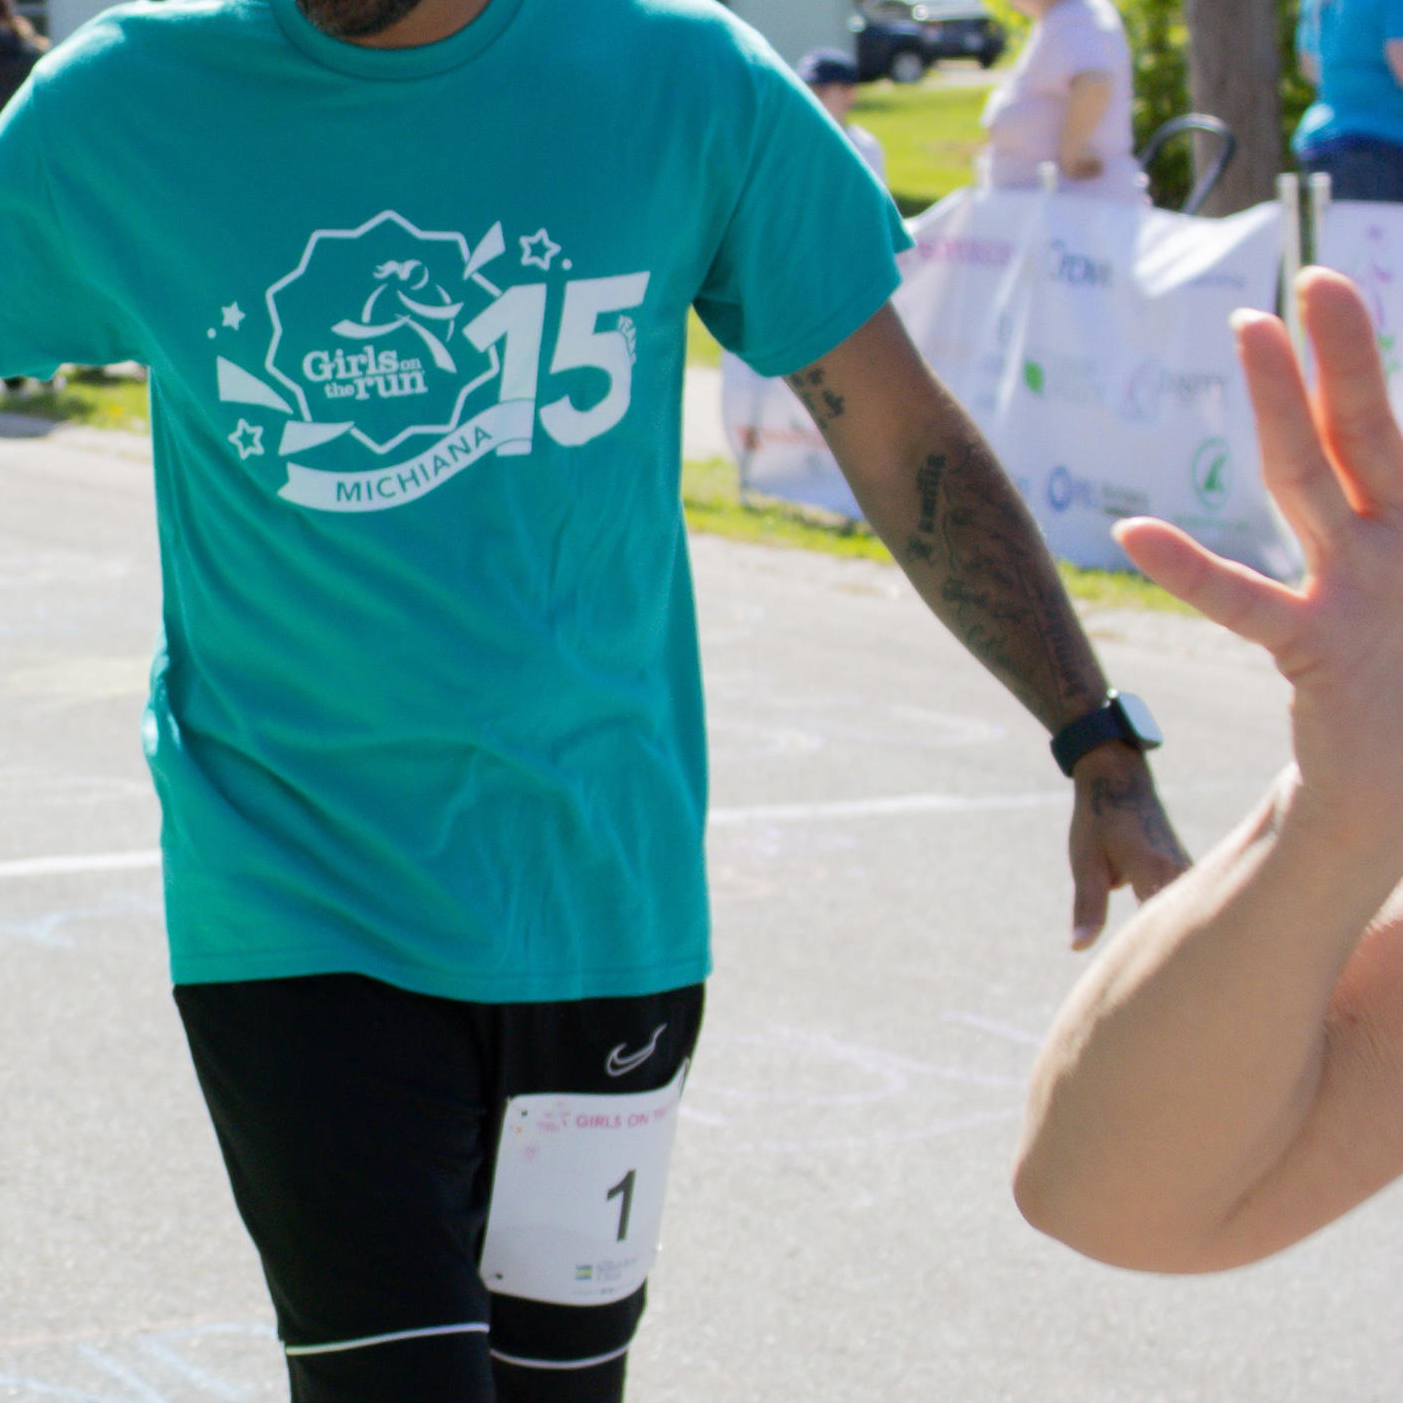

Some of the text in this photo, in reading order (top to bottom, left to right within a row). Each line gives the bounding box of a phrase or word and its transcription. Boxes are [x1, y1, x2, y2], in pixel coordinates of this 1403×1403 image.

[302, 345, 422, 382] Girls on
[325, 370, 429, 400] the run
[463, 270, 651, 456] 15
[336, 426, 493, 503] MICHIANA
[575, 1112, 650, 1129] GIRLS ON
[606, 1169, 637, 1243] 1
